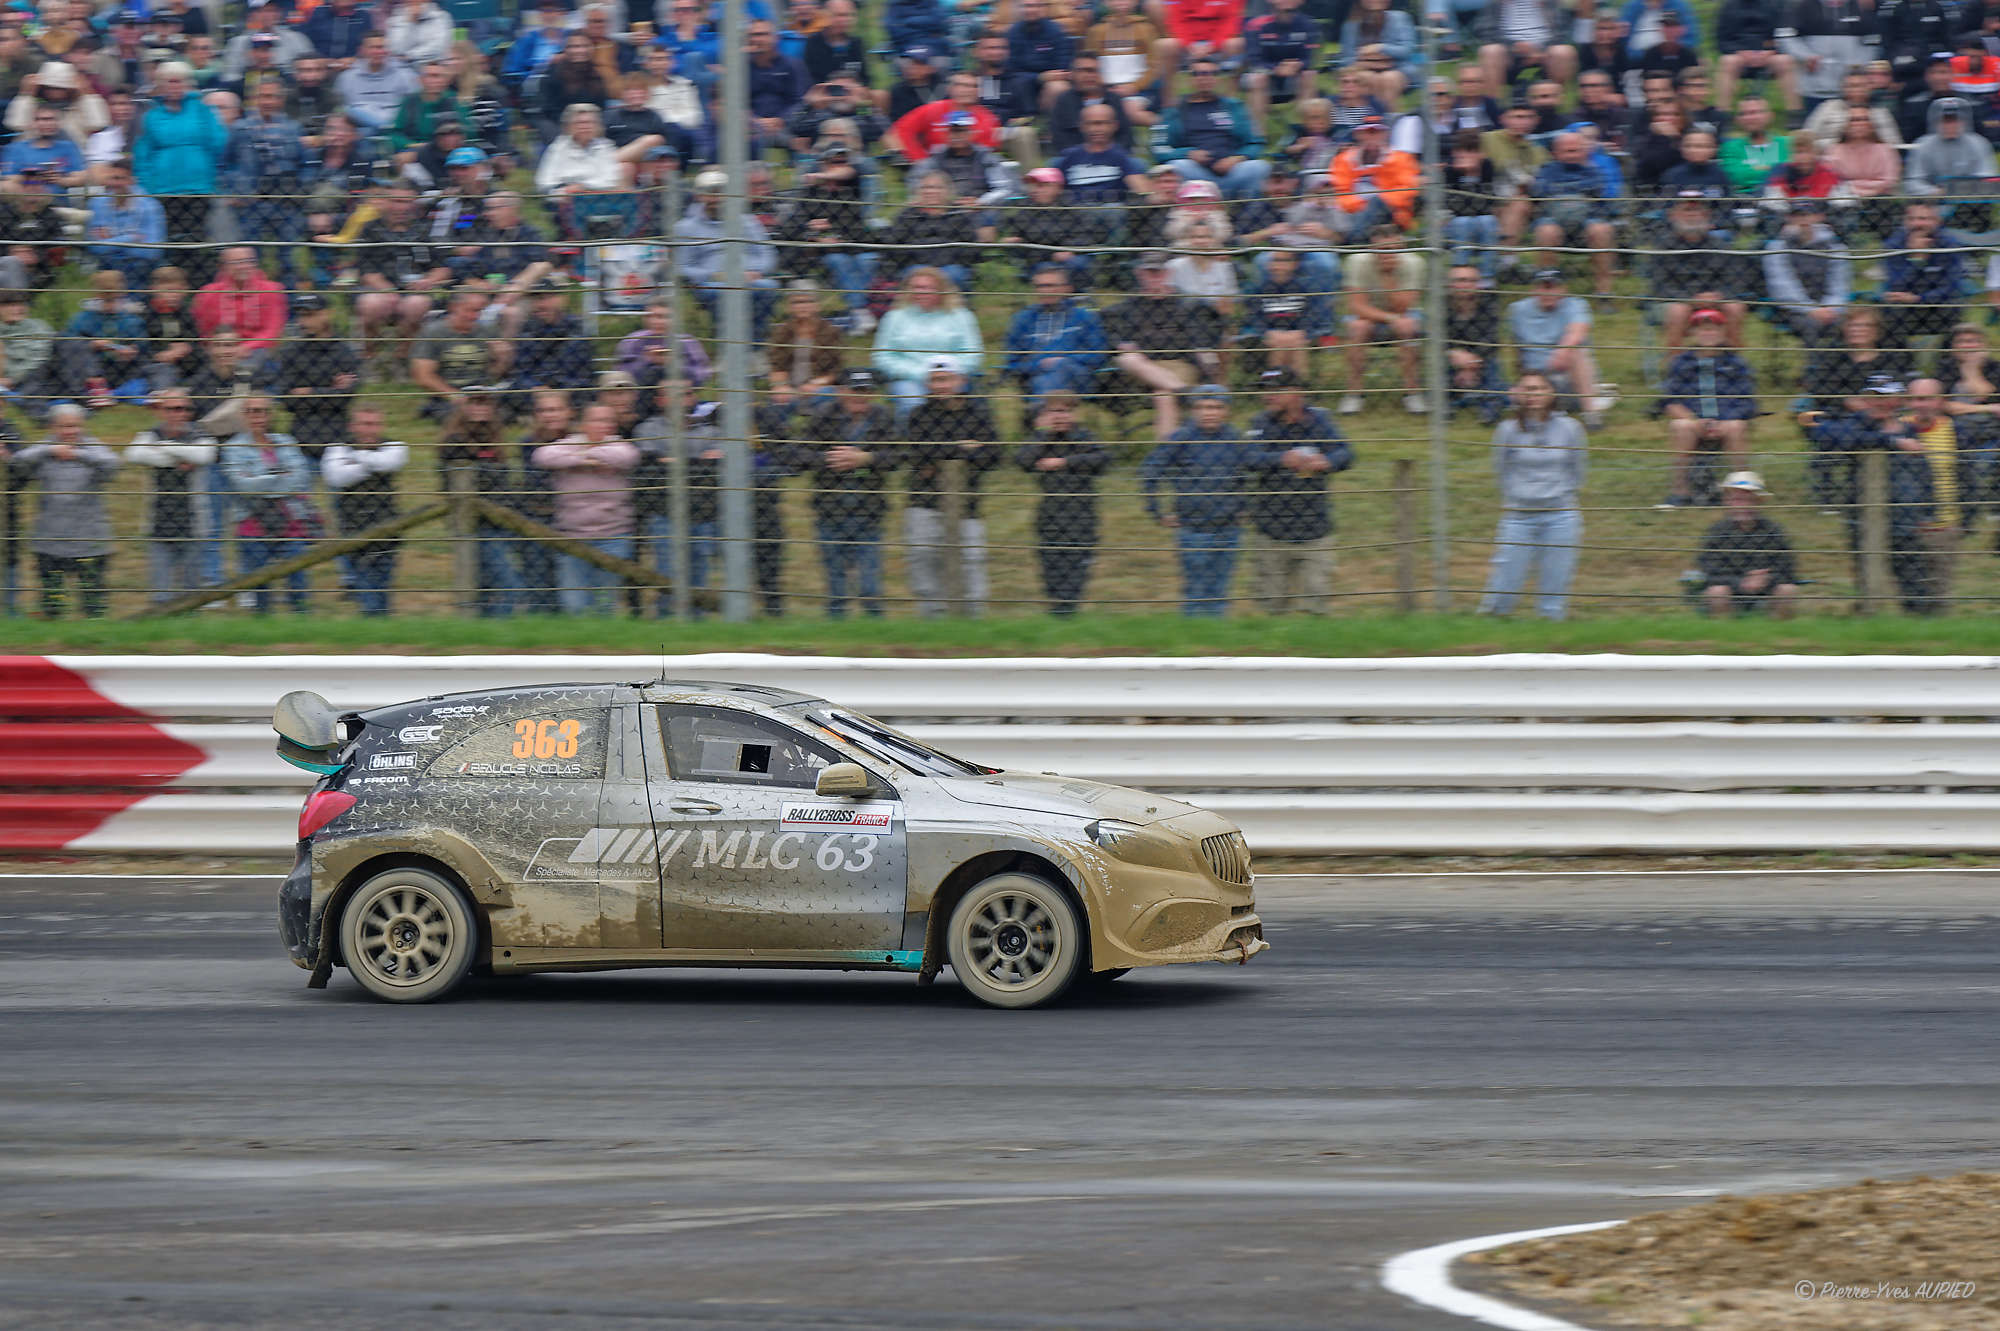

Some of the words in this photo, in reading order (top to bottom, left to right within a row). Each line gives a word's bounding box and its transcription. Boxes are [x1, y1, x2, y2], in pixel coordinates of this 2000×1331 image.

[399, 725, 444, 742] GSC
[512, 719, 580, 758] 363
[372, 755, 414, 768] ÖHLINS
[529, 763, 581, 774] NICOLAS
[787, 808, 855, 822] RALLYCROSS
[855, 814, 888, 826] FRANCE
[690, 830, 807, 870] MLC
[816, 833, 881, 872] 63
